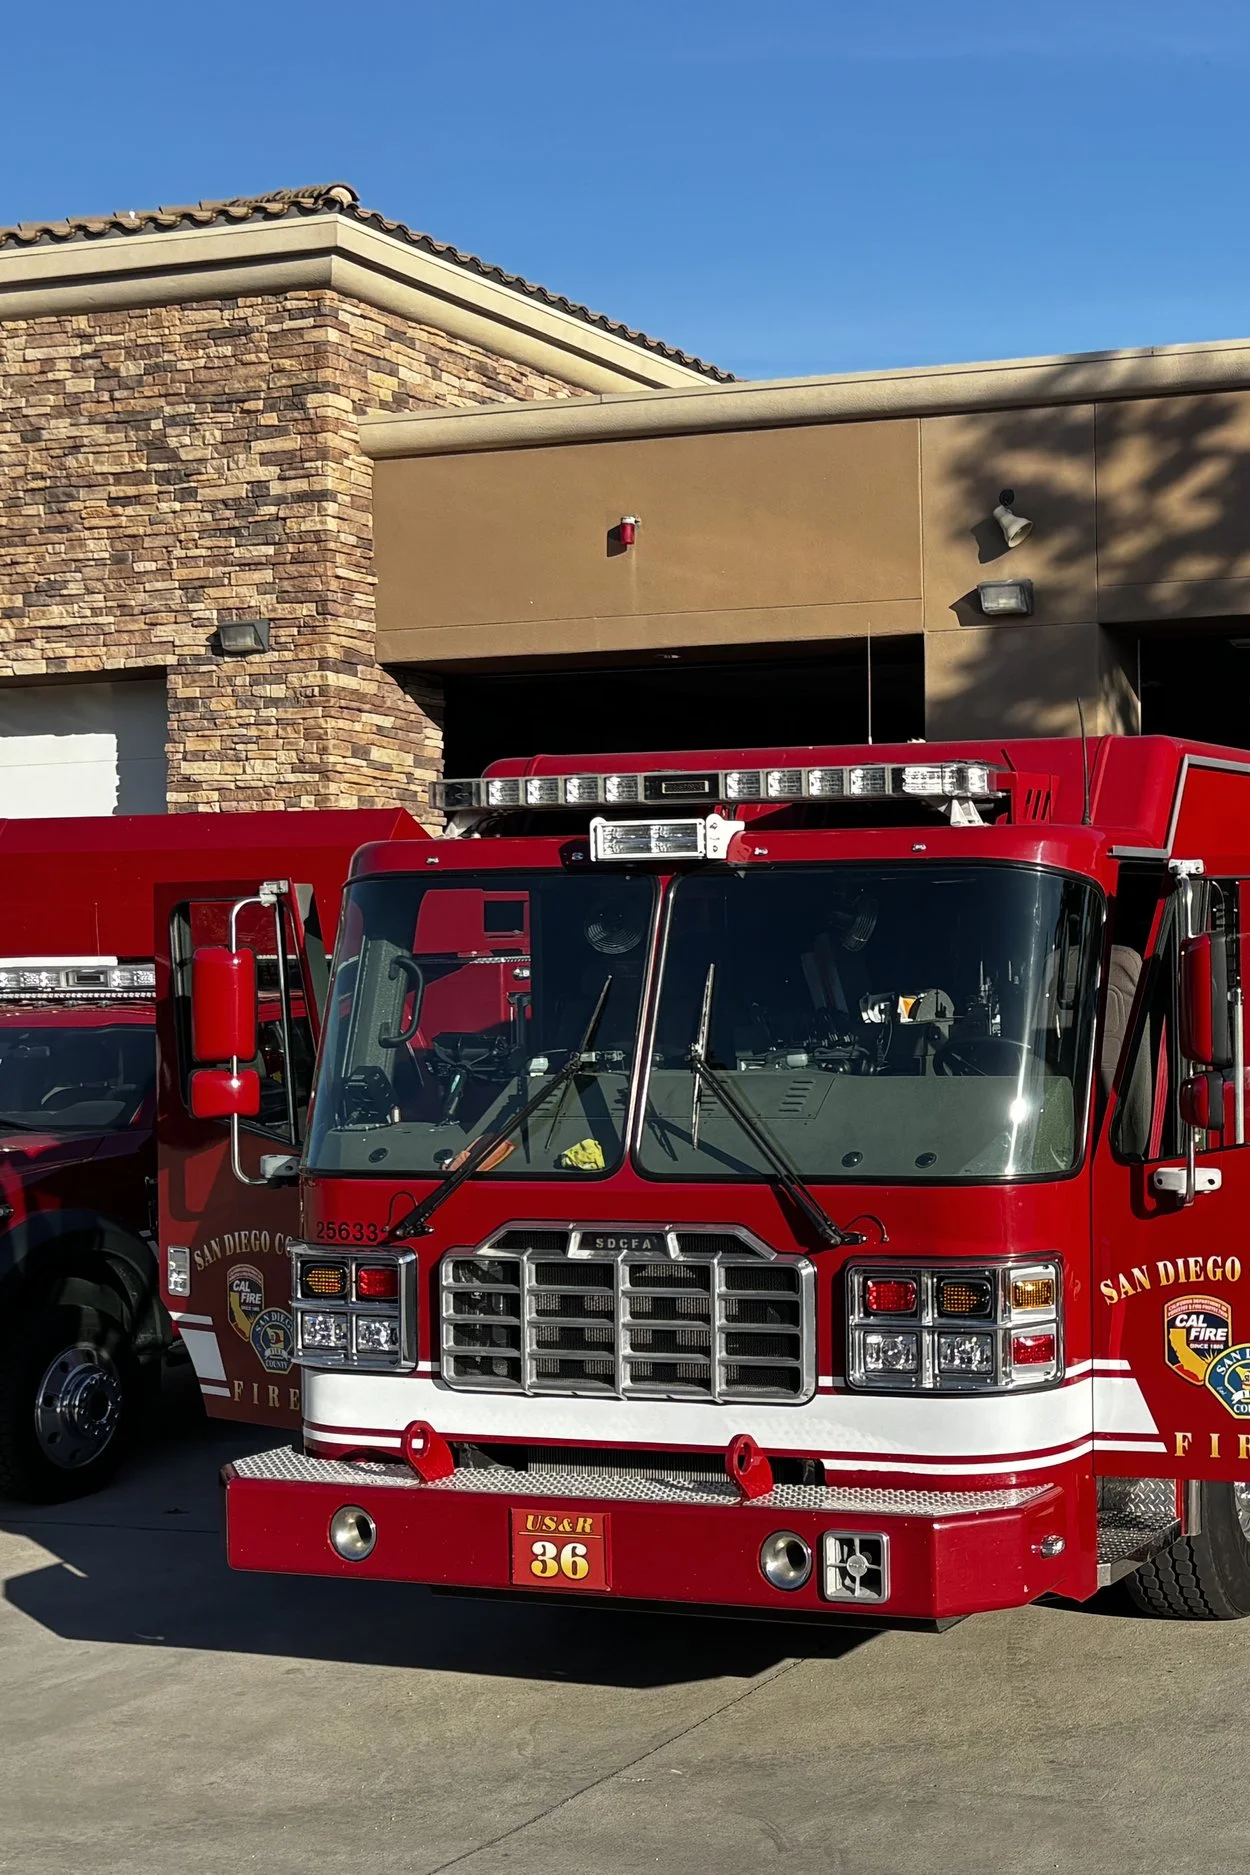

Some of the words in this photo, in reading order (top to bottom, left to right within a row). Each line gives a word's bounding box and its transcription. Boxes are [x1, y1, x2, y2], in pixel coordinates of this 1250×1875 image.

[316, 1221, 379, 1242] 25633
[194, 1237, 222, 1272] SAN
[223, 1230, 270, 1257] DIEGO
[595, 1238, 652, 1249] SDCFA
[232, 1280, 251, 1292] CAL
[1100, 1264, 1152, 1306] SAN
[1156, 1255, 1242, 1287] DIEGO
[240, 1292, 262, 1305] FIRE
[1174, 1314, 1207, 1328] CAL
[1189, 1327, 1228, 1341] FIRE
[265, 1360, 288, 1370] COUNTY
[1216, 1350, 1242, 1376] SAN
[233, 1379, 300, 1411] FIRE
[526, 1514, 593, 1533] US&R
[530, 1541, 589, 1580] 36
